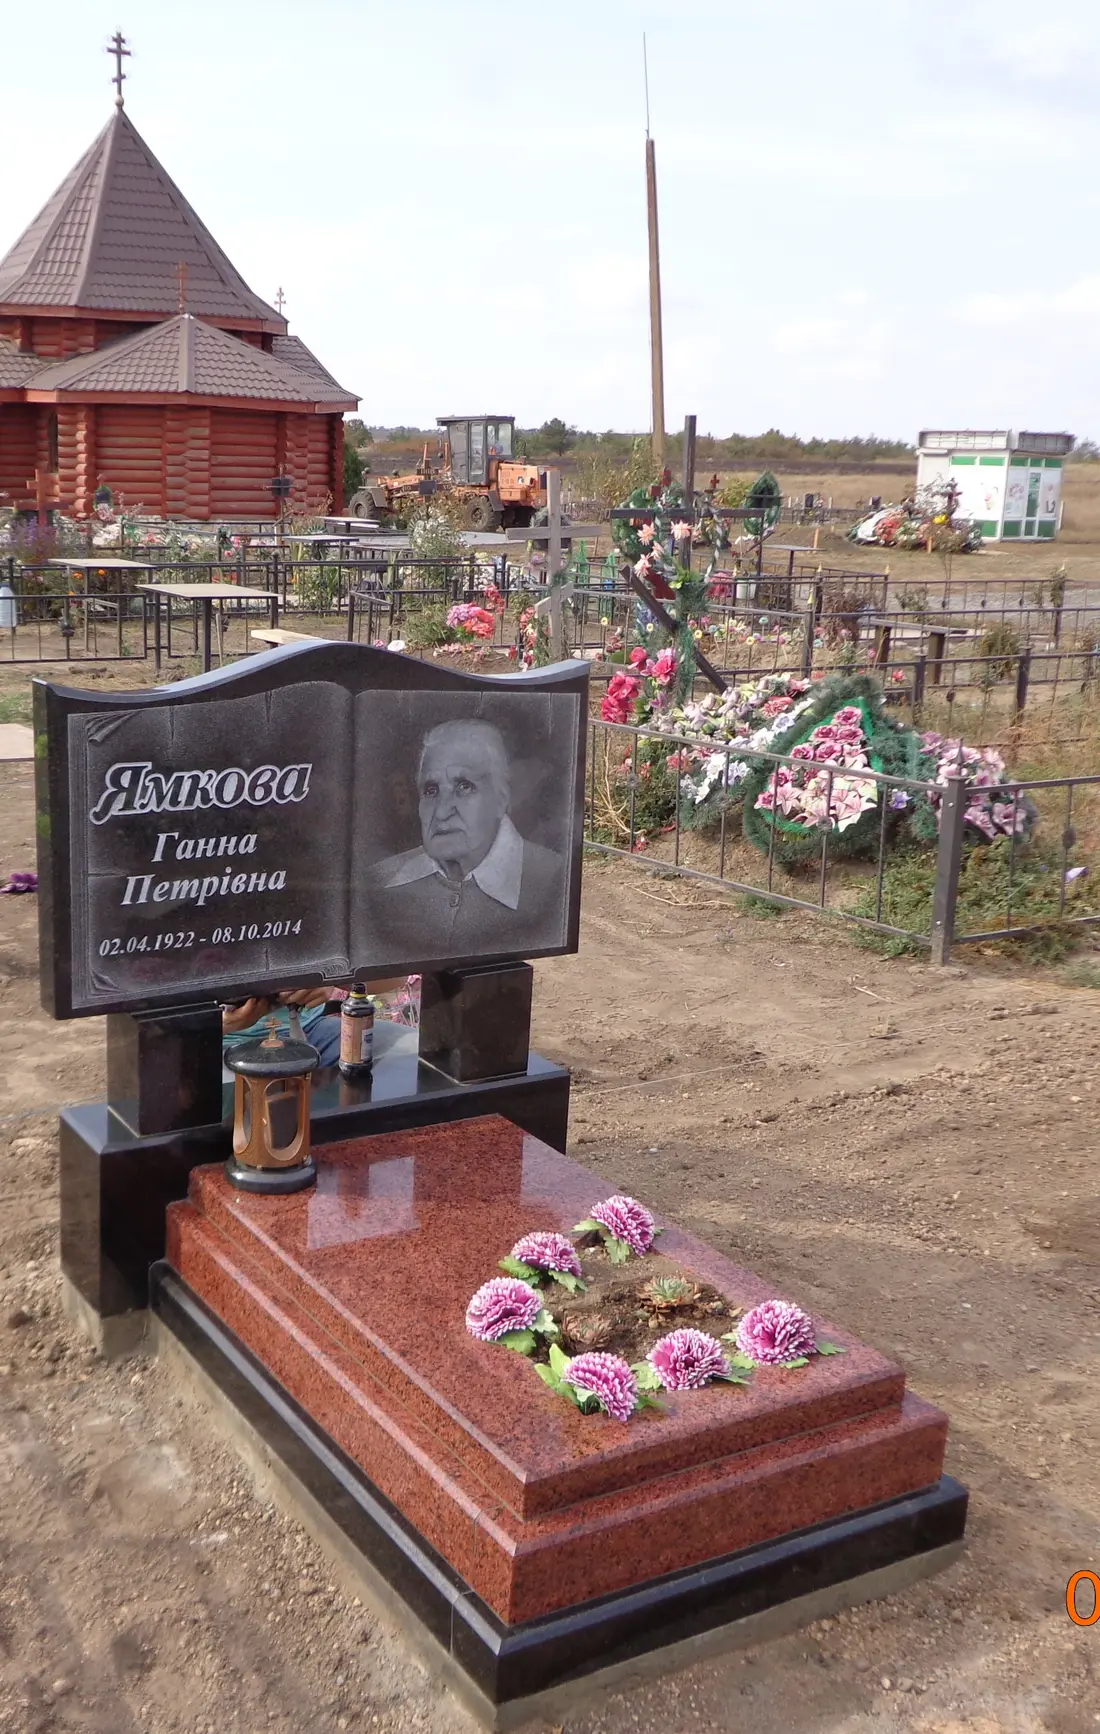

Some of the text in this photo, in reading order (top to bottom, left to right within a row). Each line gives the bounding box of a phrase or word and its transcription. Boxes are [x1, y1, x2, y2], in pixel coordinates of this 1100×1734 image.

[90, 762, 313, 825] Ямкова
[151, 832, 258, 862] Ганна
[120, 867, 287, 906] Петрівна
[99, 932, 195, 957] 02.04.1922
[211, 919, 302, 945] 08.10.2014
